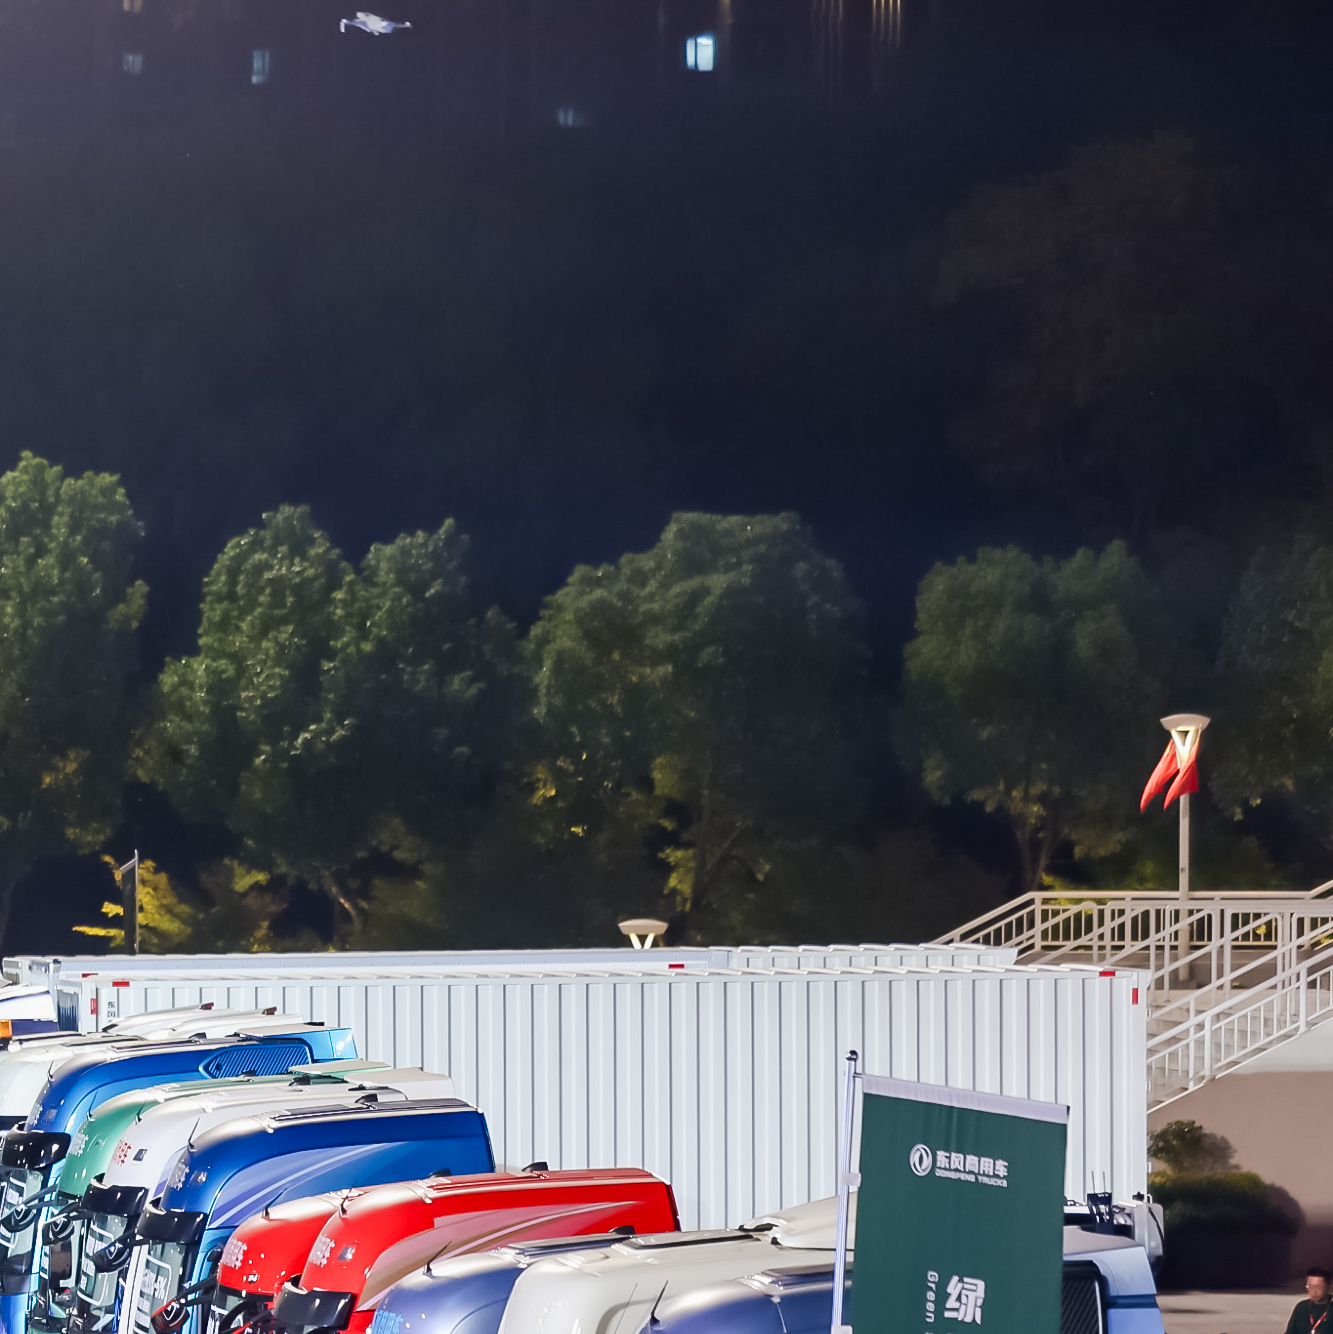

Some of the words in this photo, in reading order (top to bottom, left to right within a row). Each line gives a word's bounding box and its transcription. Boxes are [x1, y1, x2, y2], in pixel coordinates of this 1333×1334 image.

[935, 1150, 1009, 1178] 东风商用车
[978, 1175, 1008, 1187] TRUCKS
[925, 1270, 938, 1323] Green
